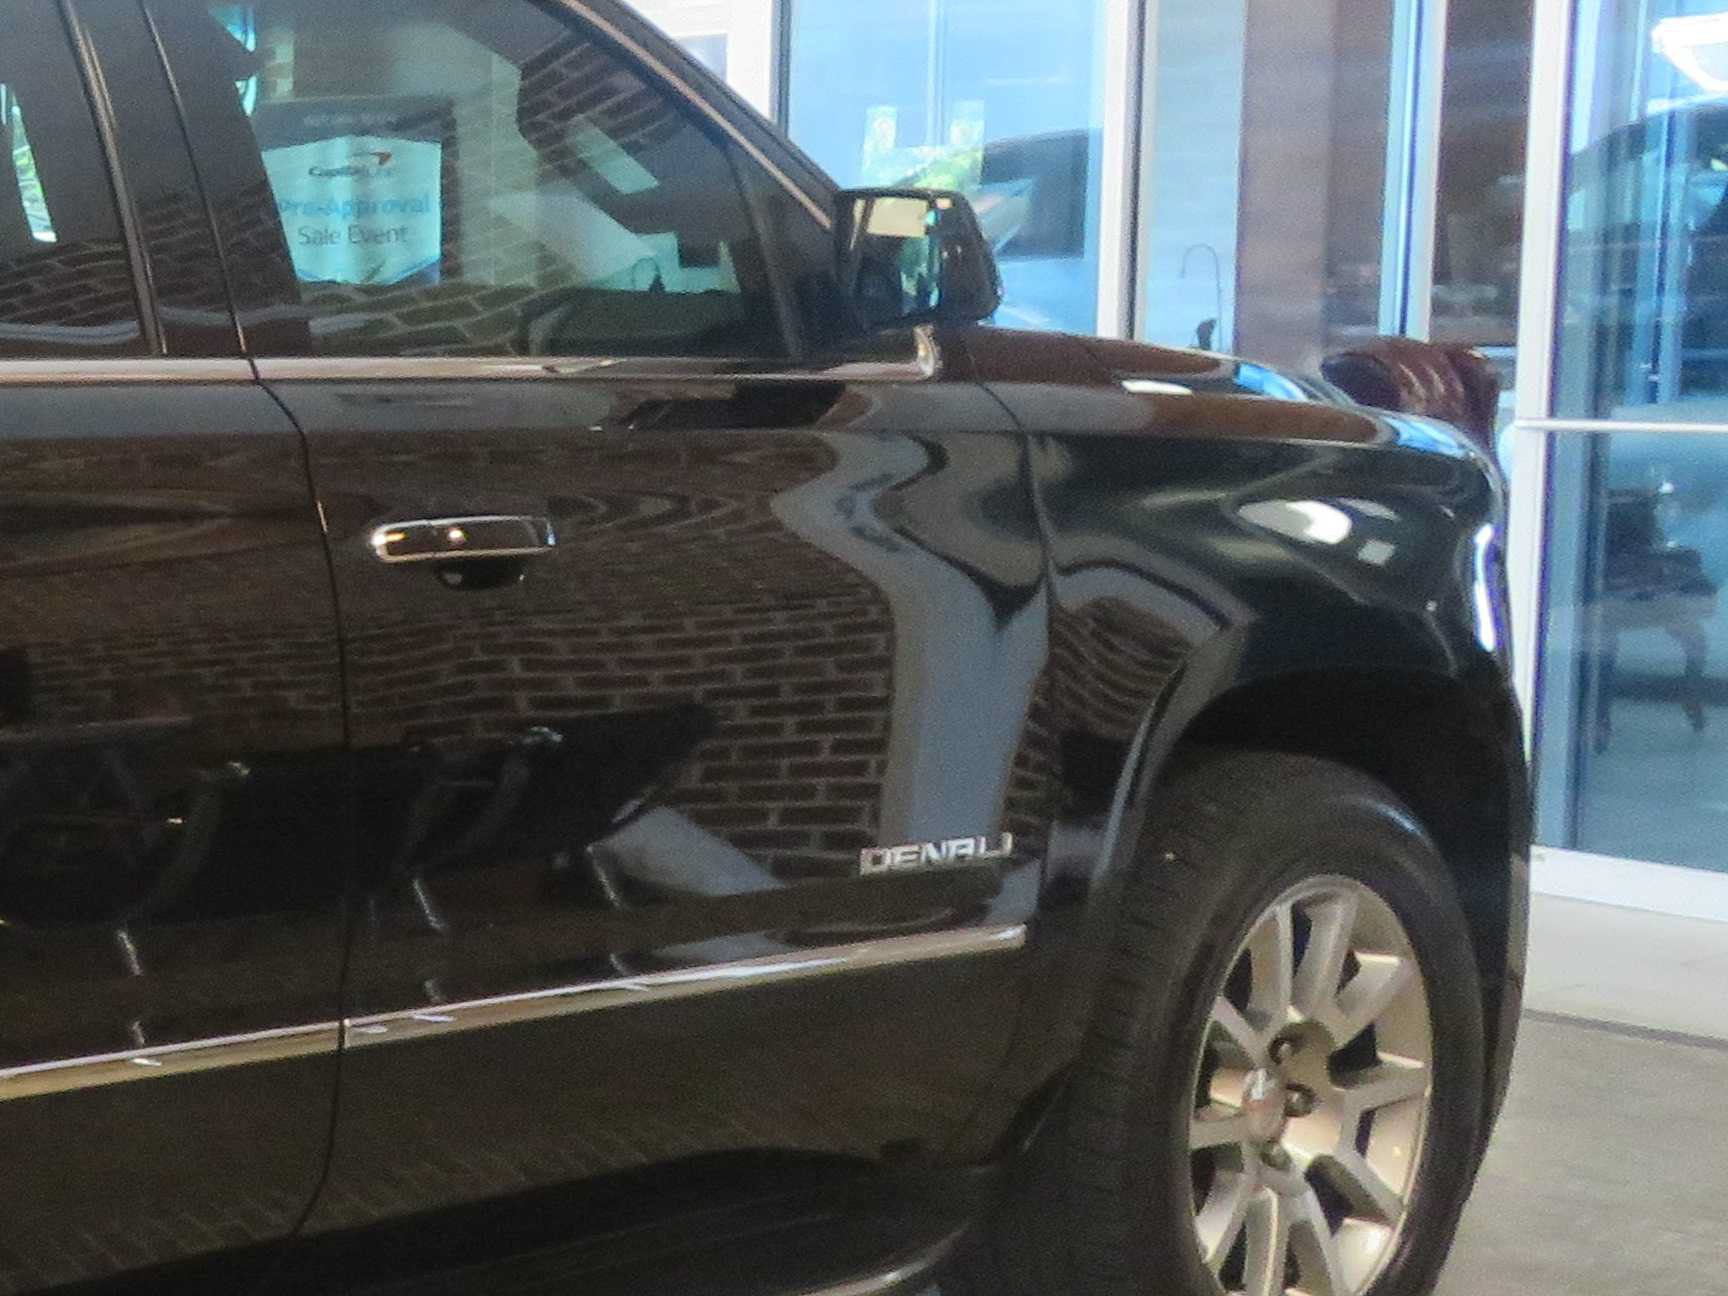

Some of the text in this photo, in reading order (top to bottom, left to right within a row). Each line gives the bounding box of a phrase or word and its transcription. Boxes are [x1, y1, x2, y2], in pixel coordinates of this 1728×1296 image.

[297, 224, 409, 245] Sale Event
[859, 831, 1013, 876] DENALI
